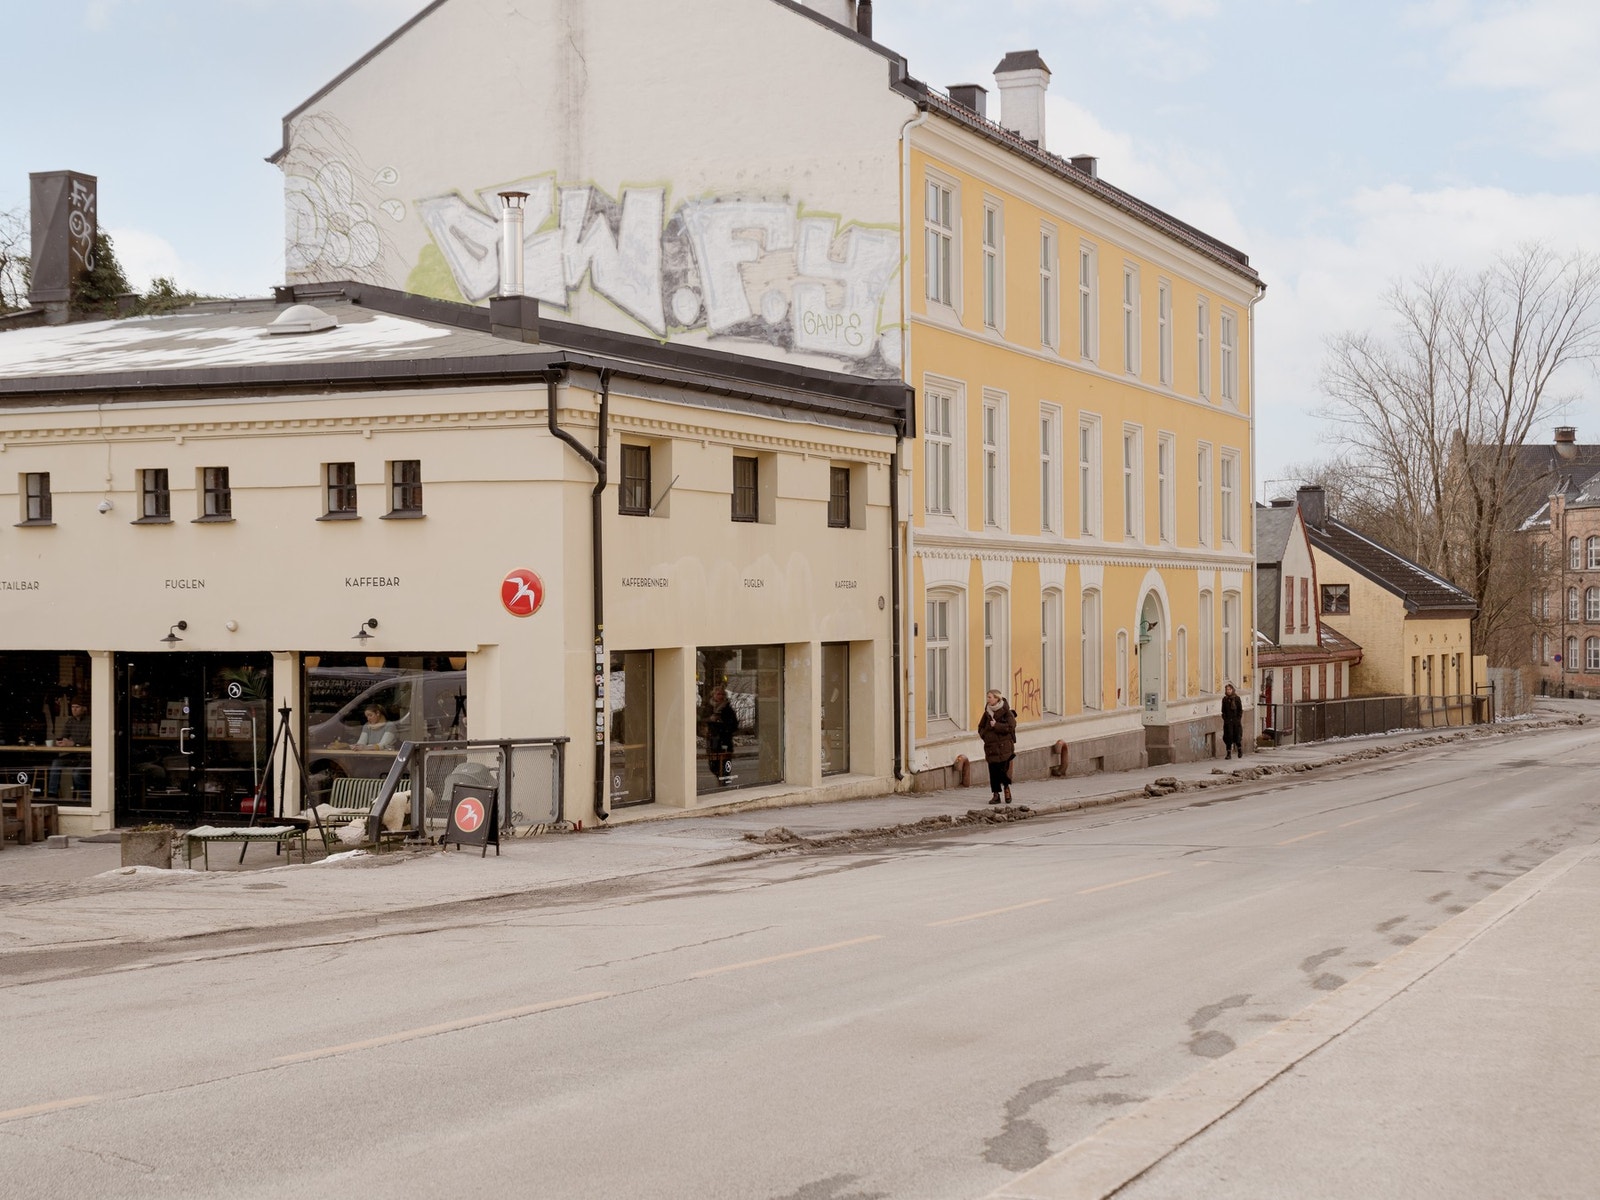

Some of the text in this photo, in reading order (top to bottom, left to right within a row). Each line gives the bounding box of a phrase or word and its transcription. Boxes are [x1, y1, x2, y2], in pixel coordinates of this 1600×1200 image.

[0, 580, 40, 591] TAILBAR
[164, 578, 206, 590] FUGLEN
[344, 576, 401, 588] KAFFEBAR
[621, 576, 669, 588] KAFFEBRENNERI
[743, 578, 765, 588] FUGLEN
[834, 580, 858, 589] KAFFEBAR
